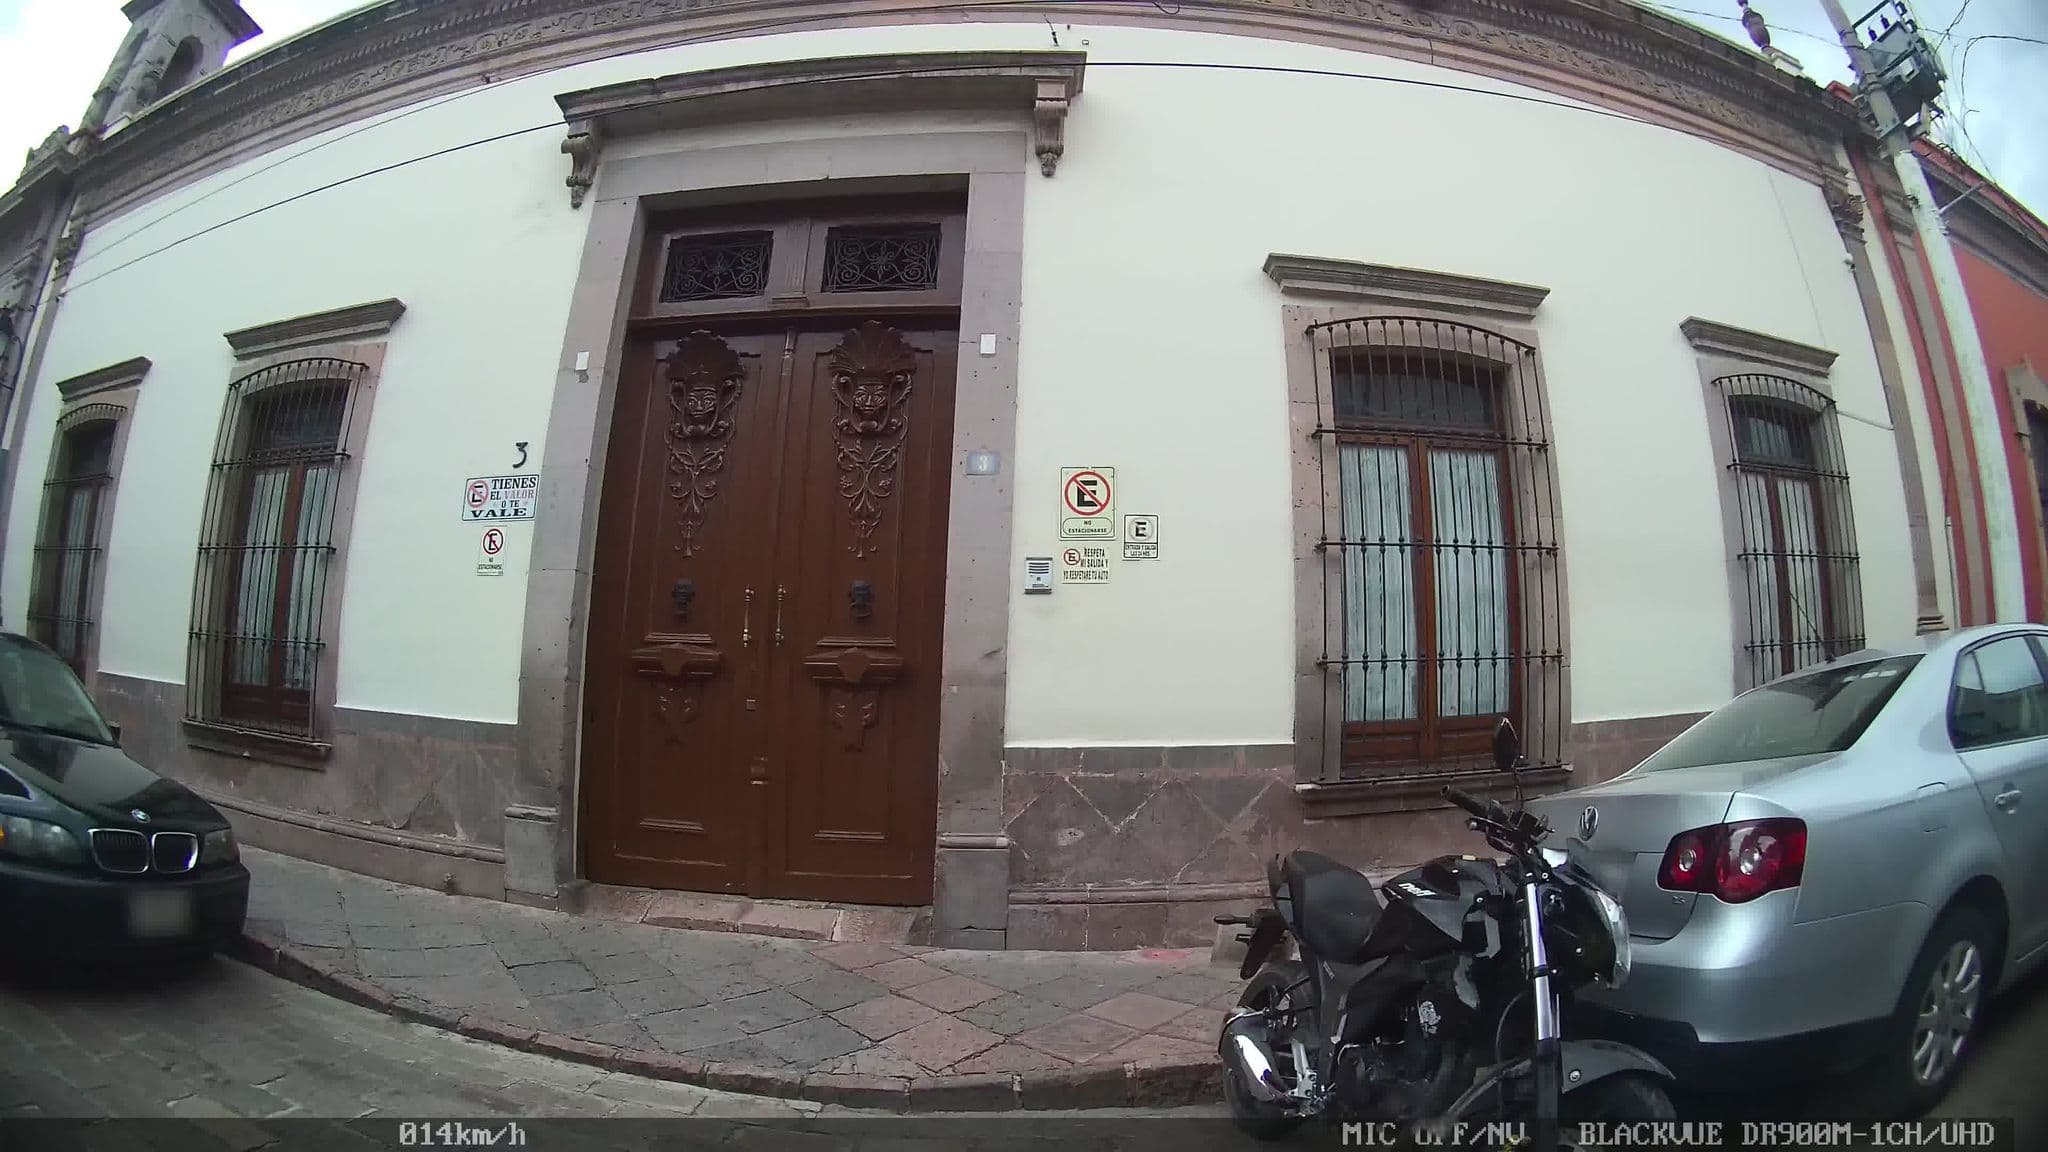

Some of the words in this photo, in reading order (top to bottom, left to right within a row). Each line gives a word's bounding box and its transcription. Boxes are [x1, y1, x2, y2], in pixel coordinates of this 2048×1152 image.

[512, 441, 529, 469] 3
[978, 455, 989, 472] 3
[491, 477, 537, 490] TIENES
[490, 491, 501, 501] EL
[504, 490, 534, 501] VALOR
[501, 500, 507, 508] O
[510, 499, 520, 508] TE
[471, 507, 527, 518] VALE
[1084, 548, 1105, 557] RESPETA
[1087, 559, 1104, 568] SALIDA
[1105, 559, 1109, 568] Y
